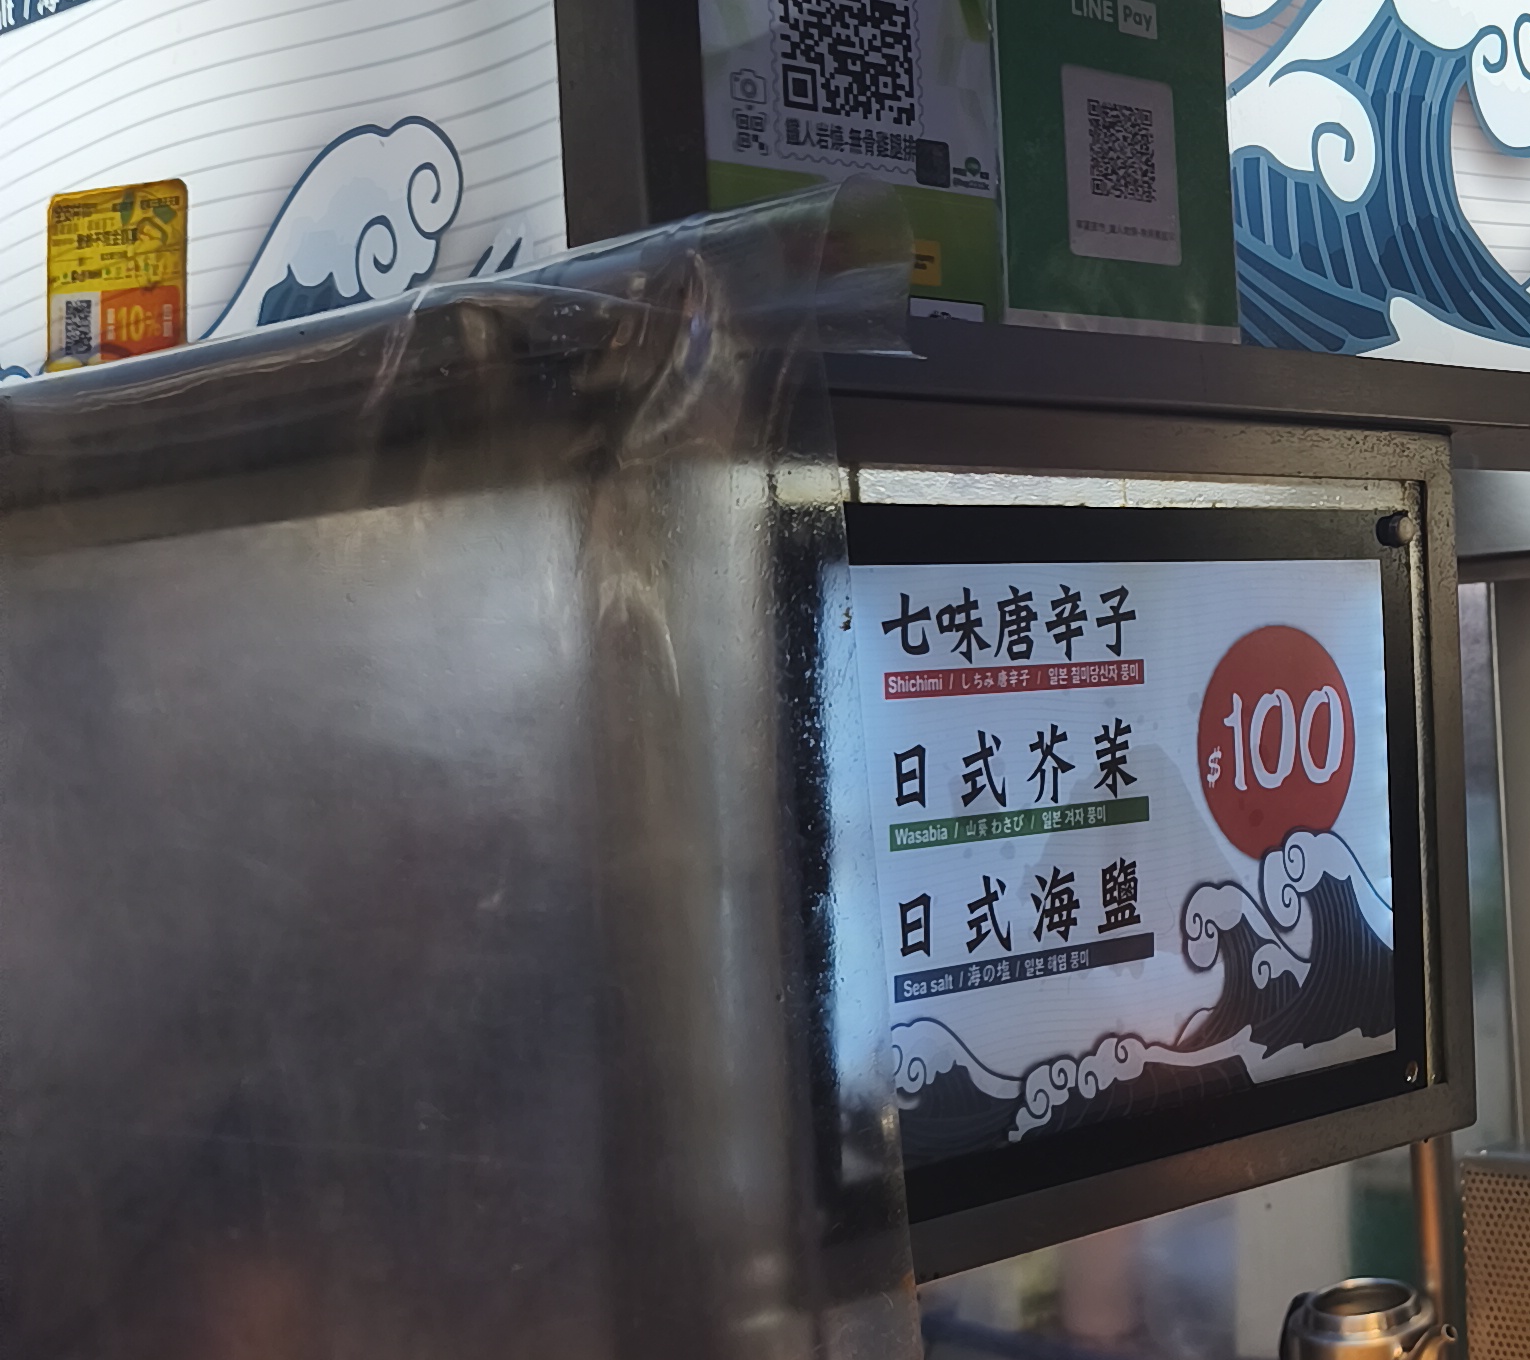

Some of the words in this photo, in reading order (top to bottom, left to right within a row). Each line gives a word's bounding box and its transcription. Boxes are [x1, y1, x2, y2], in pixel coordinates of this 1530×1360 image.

[1123, 2, 1154, 33] Pay
[881, 584, 1137, 664] 七味唐辛子
[888, 674, 943, 694] Shichimi
[1048, 666, 1069, 686] 일본
[1120, 662, 1139, 682] 풍미
[893, 717, 1138, 808] 日式芥茉
[894, 824, 949, 846] Wasabia
[1042, 810, 1063, 830] 일본
[1086, 804, 1107, 824] 풍미
[898, 857, 1141, 957] 日式海鹽
[903, 979, 928, 998] Sea
[930, 972, 954, 992] salt
[1069, 948, 1090, 969] 풍미
